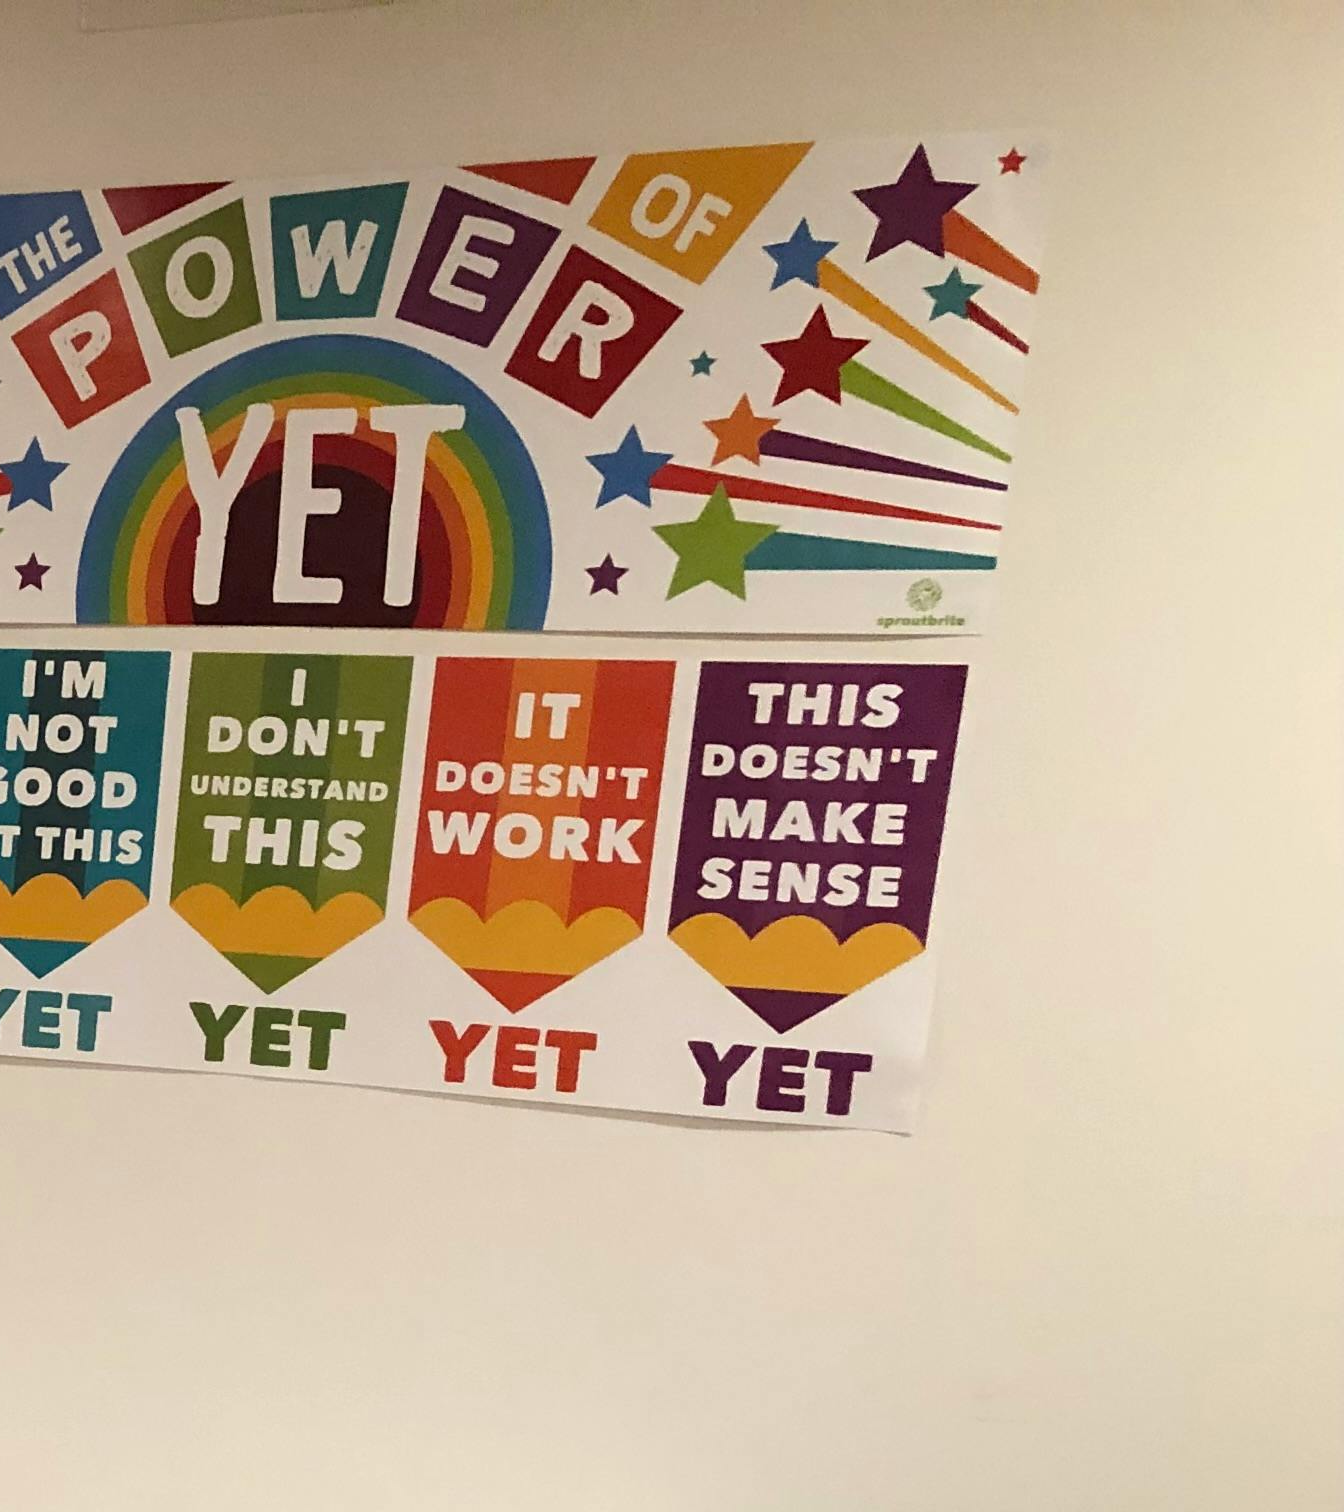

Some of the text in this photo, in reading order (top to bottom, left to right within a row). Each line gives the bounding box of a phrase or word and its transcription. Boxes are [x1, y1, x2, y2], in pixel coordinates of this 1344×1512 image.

[49, 215, 635, 402] POWER
[630, 173, 733, 253] OF
[174, 403, 467, 607] YET
[876, 614, 966, 629] sproutbrite
[22, 659, 106, 699] I'M
[291, 668, 307, 707] I
[514, 692, 581, 740] IT
[748, 682, 904, 728] THIS
[5, 713, 118, 754] NOT
[206, 715, 386, 758] DON'T
[435, 760, 649, 800] DOESN'T
[701, 743, 938, 783] DOESN'T
[190, 774, 389, 802] UNDERSTAND
[203, 814, 366, 871] THIS
[428, 810, 645, 864] WORK
[711, 798, 908, 845] MAKE
[35, 826, 144, 865] THIS
[697, 857, 902, 908] SENSE
[189, 1001, 346, 1071] YET
[428, 1019, 598, 1093] YET
[687, 1041, 873, 1116] YET
